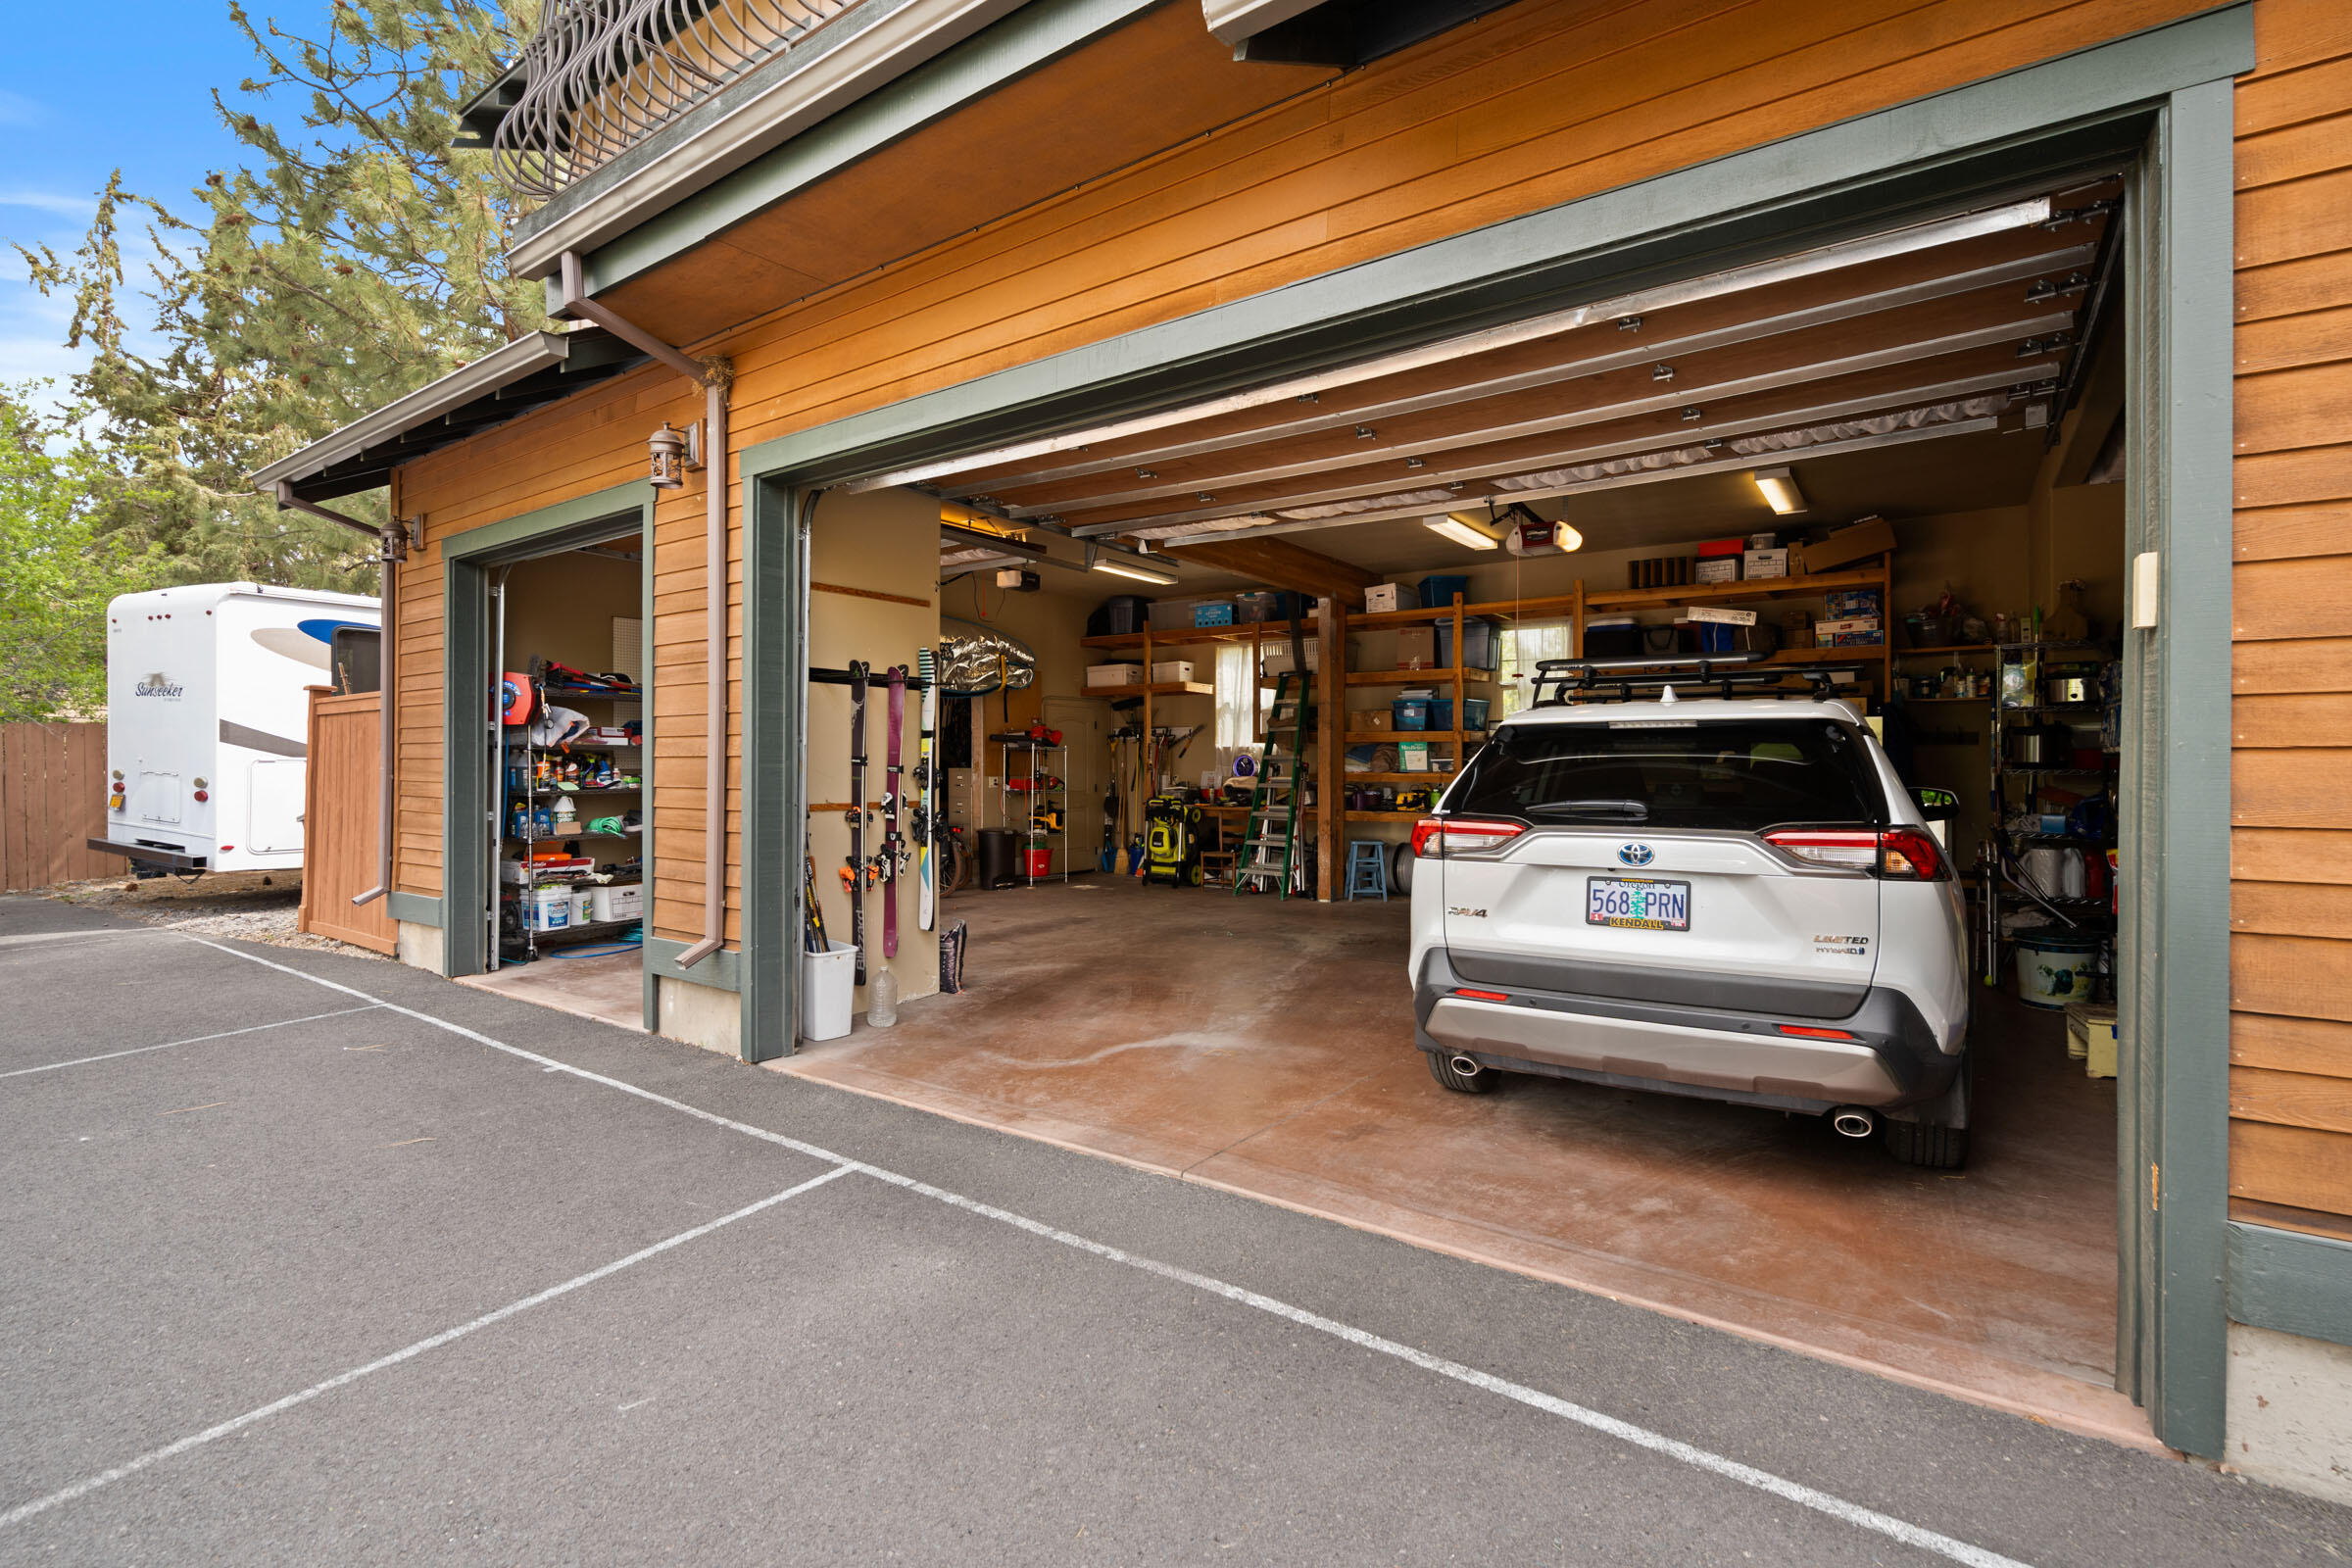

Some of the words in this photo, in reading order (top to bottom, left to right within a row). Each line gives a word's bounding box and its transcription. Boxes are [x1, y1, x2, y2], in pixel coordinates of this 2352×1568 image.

[135, 681, 183, 697] Sunseeker
[1592, 889, 1630, 915] 568
[1645, 892, 1685, 918] PRN
[1610, 916, 1663, 929] KENDALL
